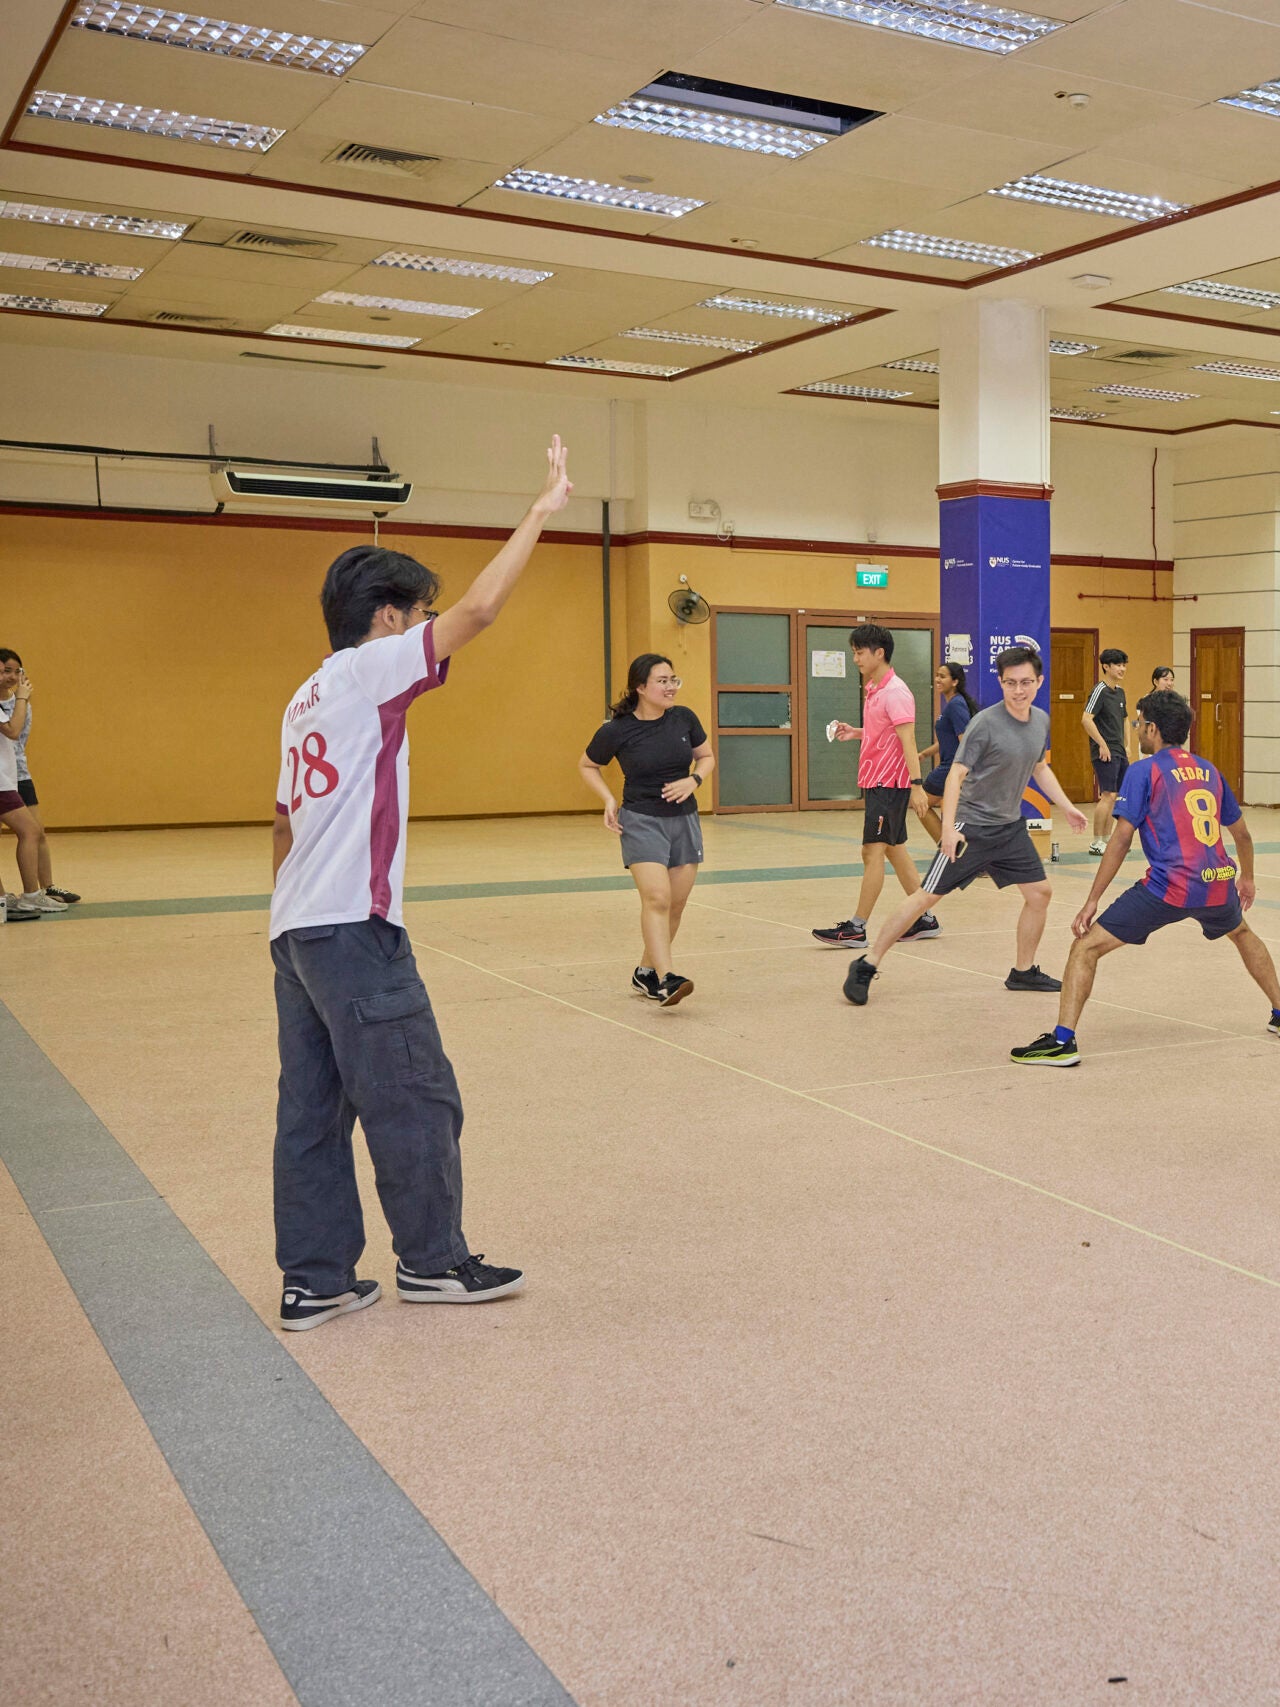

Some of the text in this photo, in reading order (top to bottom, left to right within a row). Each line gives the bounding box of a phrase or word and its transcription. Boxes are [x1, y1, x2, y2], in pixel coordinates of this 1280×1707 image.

[996, 556, 1010, 564] NUS
[863, 573, 881, 585] EXIT
[989, 636, 1011, 645] NUS
[287, 731, 339, 814] 28
[1170, 766, 1210, 783] PEDRI
[1184, 788, 1221, 848] 8
